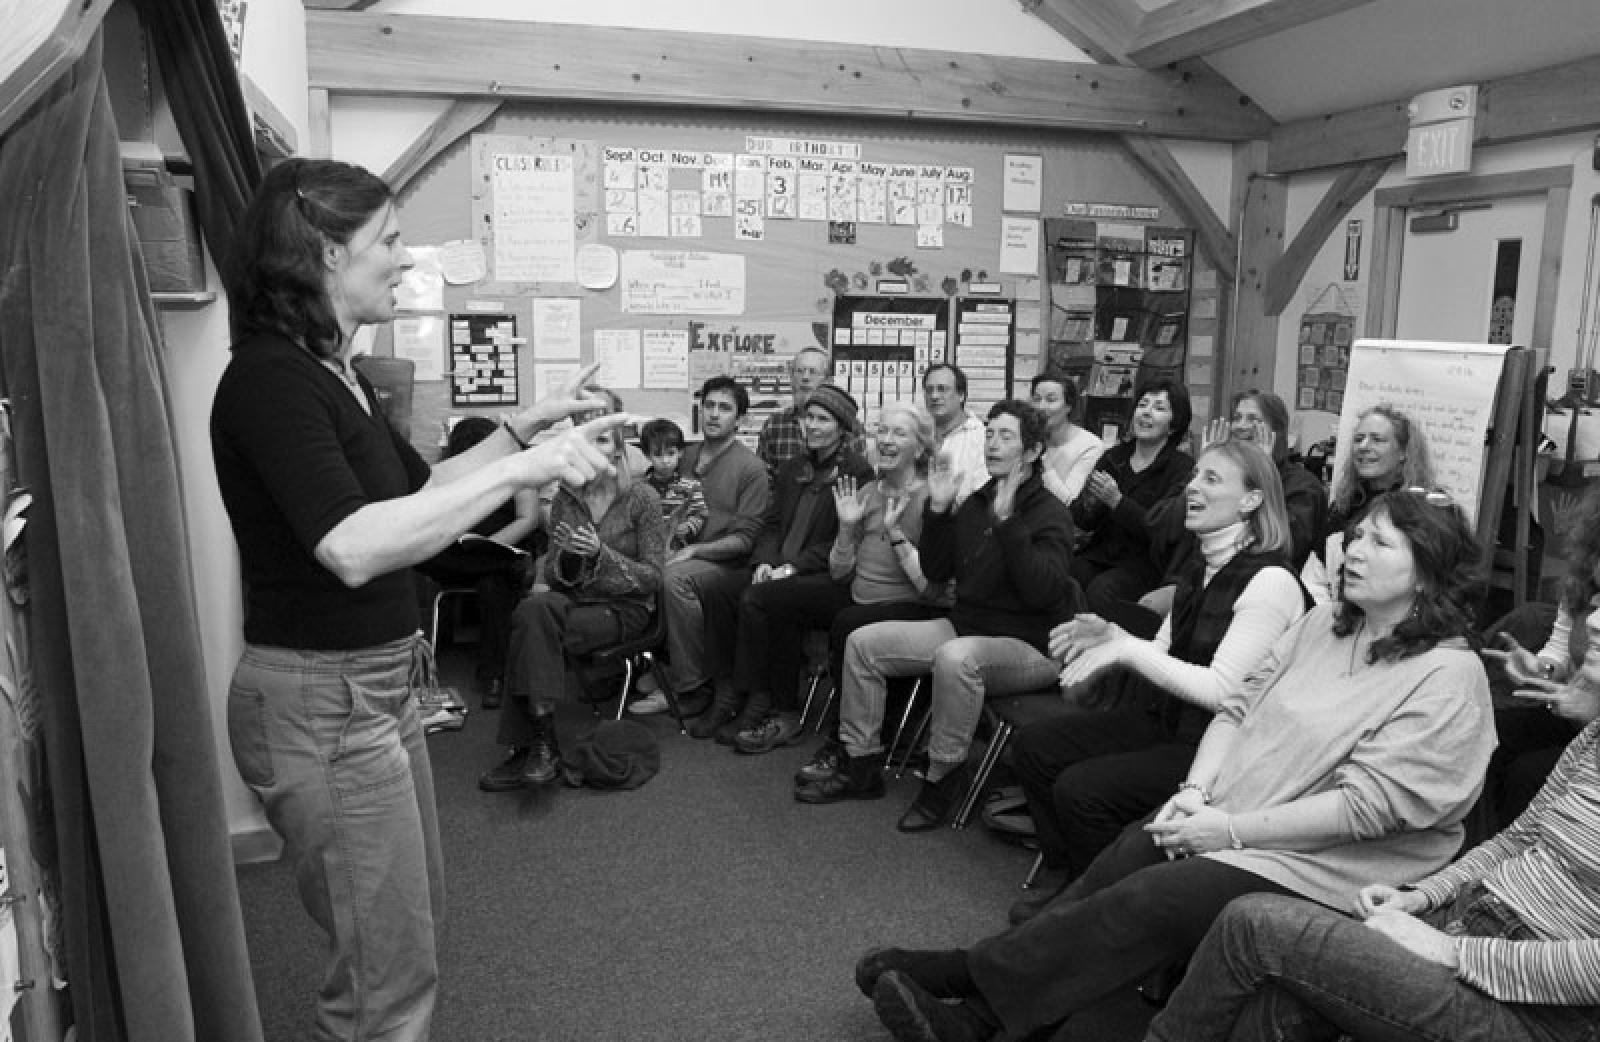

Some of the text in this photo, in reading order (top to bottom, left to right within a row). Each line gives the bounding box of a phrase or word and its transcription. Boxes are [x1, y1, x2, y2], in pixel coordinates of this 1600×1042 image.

[1416, 128, 1459, 168] EXIT
[861, 163, 887, 178] May
[889, 167, 915, 177] June
[920, 167, 943, 180] July
[773, 175, 787, 195] 3
[864, 313, 924, 327] December
[839, 363, 847, 375] 3
[871, 363, 879, 375] 5
